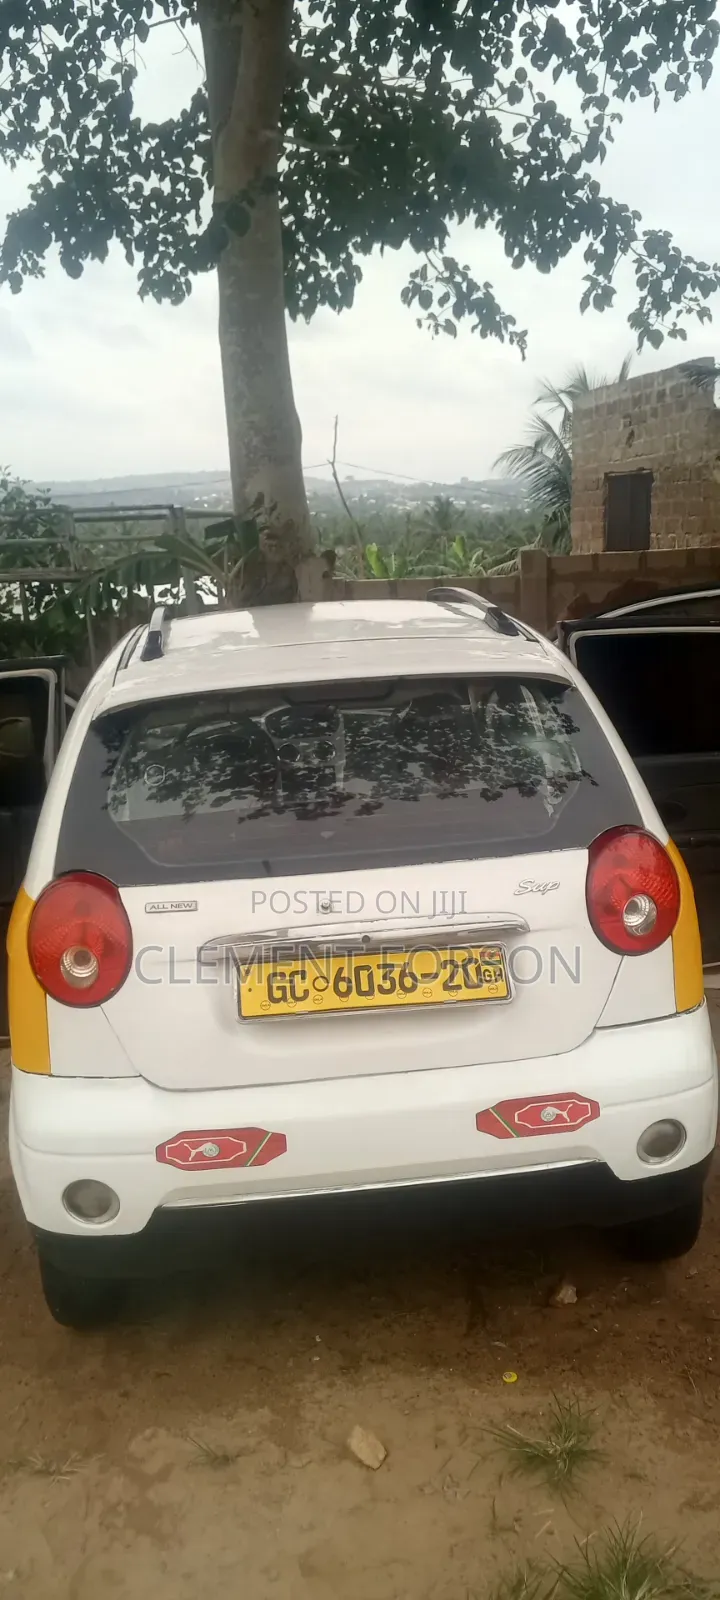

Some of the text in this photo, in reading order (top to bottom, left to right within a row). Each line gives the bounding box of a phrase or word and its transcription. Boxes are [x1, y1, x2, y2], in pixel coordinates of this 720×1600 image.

[513, 878, 561, 896] Sup
[149, 902, 194, 911] ALL NEW
[482, 967, 504, 984] GH
[266, 969, 310, 1005] GC
